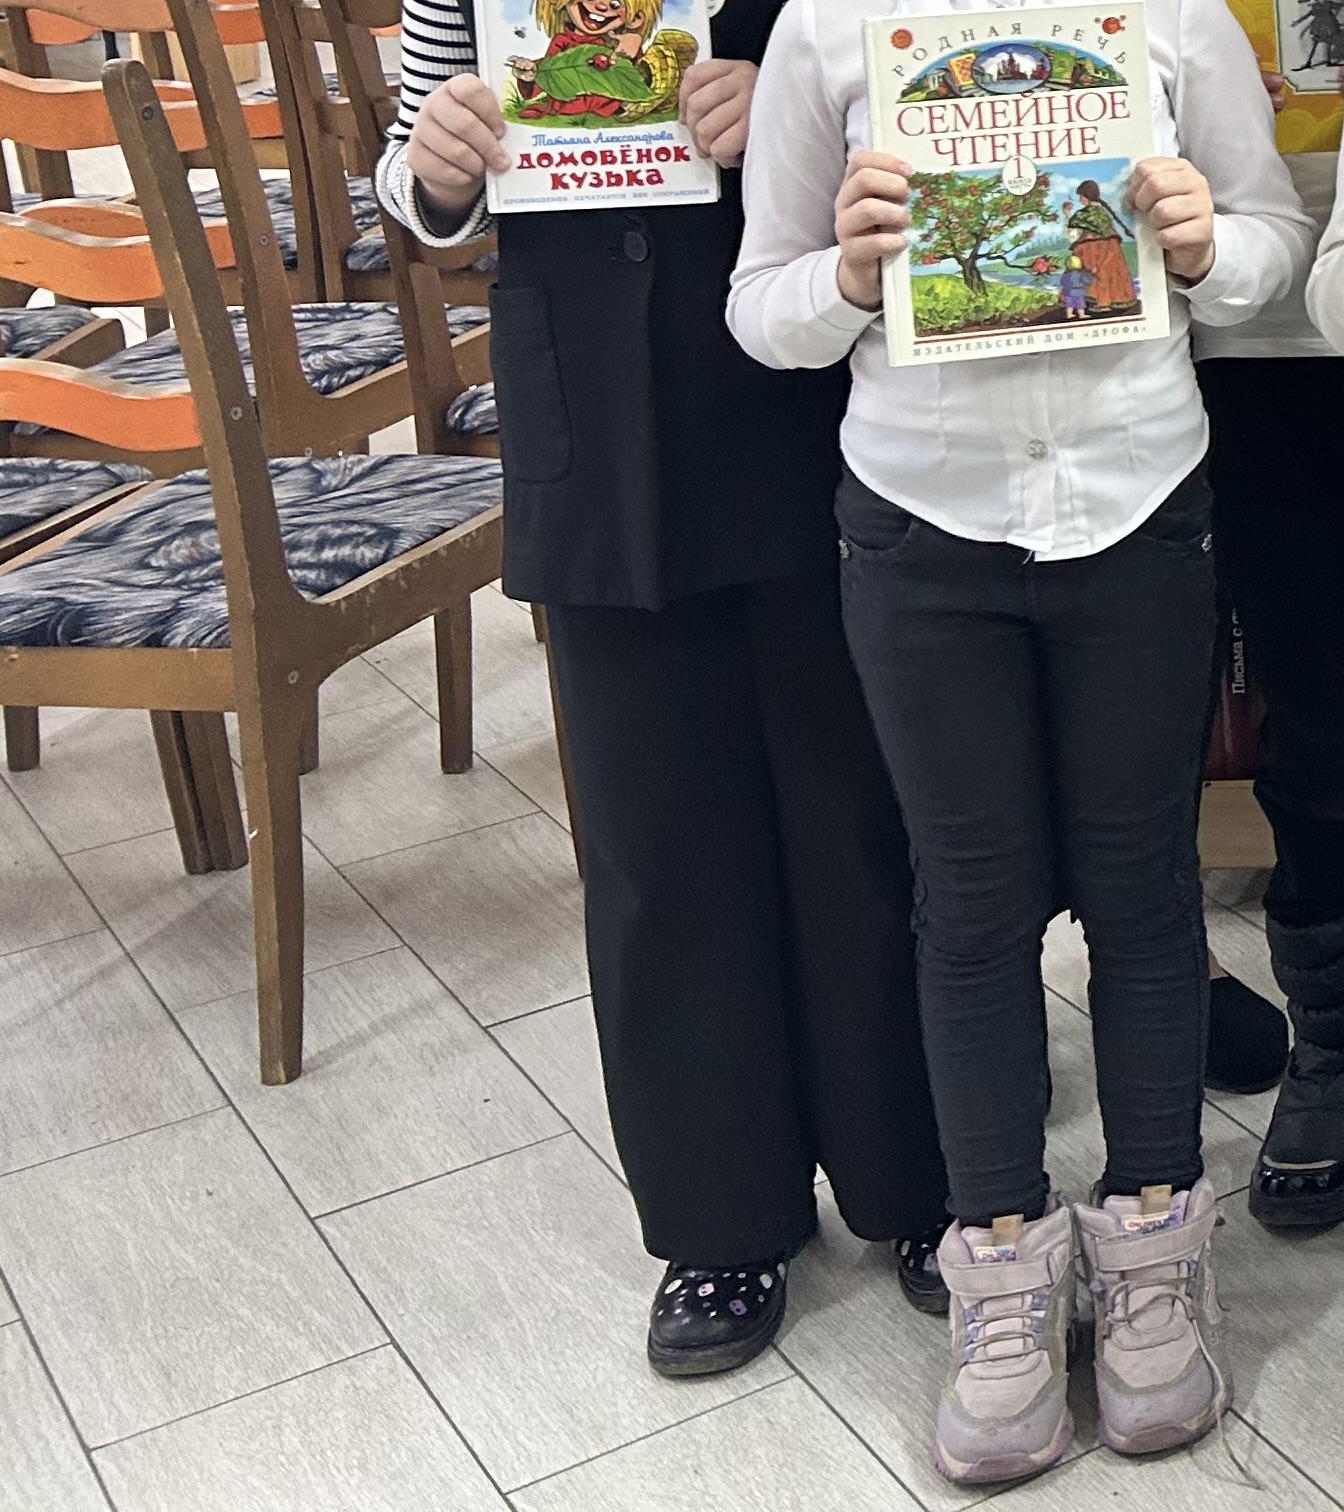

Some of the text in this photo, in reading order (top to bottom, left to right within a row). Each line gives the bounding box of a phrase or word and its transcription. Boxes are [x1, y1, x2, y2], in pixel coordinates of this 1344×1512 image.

[891, 22, 1128, 78] РОДНАЯ РЕЧЬ
[897, 90, 1131, 137] СЕМЕЙНОЕ
[517, 144, 691, 169] ДОМОВЁНОК
[931, 126, 1100, 166] ЧТЕНИЕ
[1013, 157, 1024, 178] 1
[1044, 332, 1075, 343] ДОМ
[1232, 641, 1246, 694] Письма
